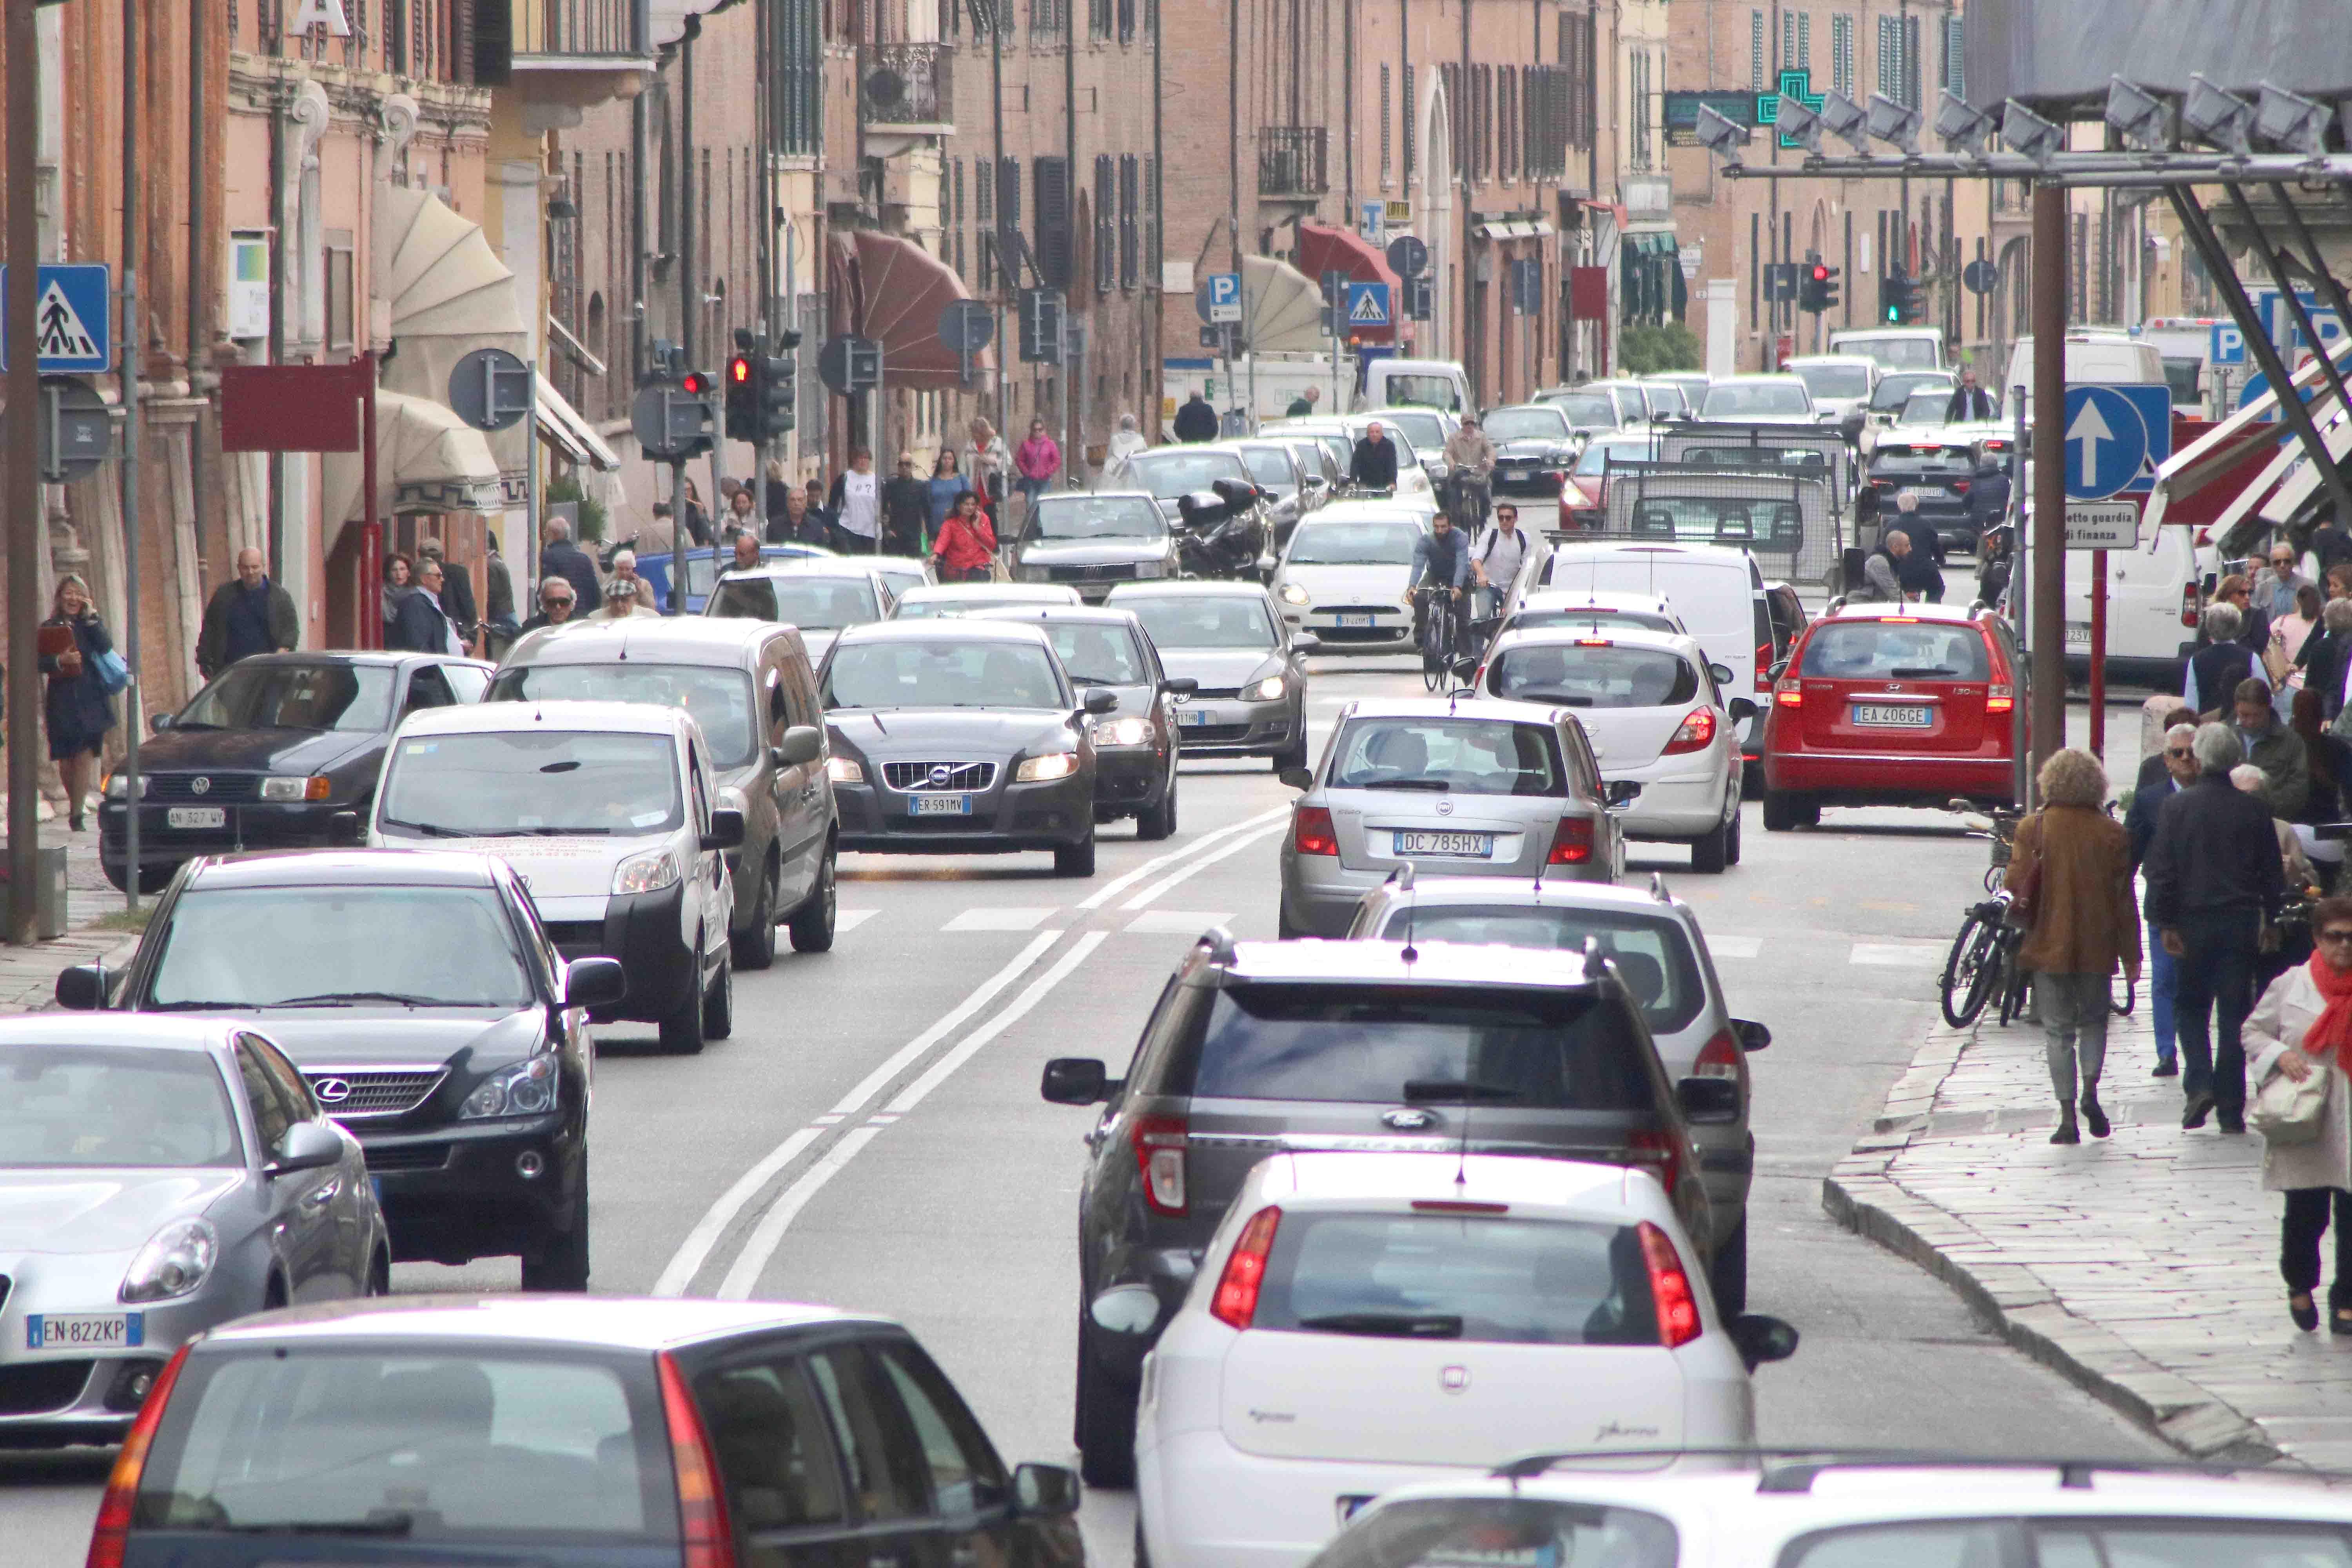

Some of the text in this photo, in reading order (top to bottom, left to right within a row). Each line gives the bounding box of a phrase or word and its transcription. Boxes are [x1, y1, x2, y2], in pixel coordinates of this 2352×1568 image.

[1214, 278, 1234, 302] P
[2219, 329, 2243, 359] P
[2066, 512, 2132, 525] etto guardia
[2078, 530, 2117, 540] finanza
[1862, 708, 1877, 722] EA
[1882, 708, 1923, 722] 406GE
[918, 800, 929, 811] ER
[934, 800, 962, 811] 591MV
[1405, 833, 1425, 850] DC
[1431, 833, 1481, 852] 785HX
[43, 1320, 65, 1341] EN
[70, 1319, 125, 1342] 822KP
